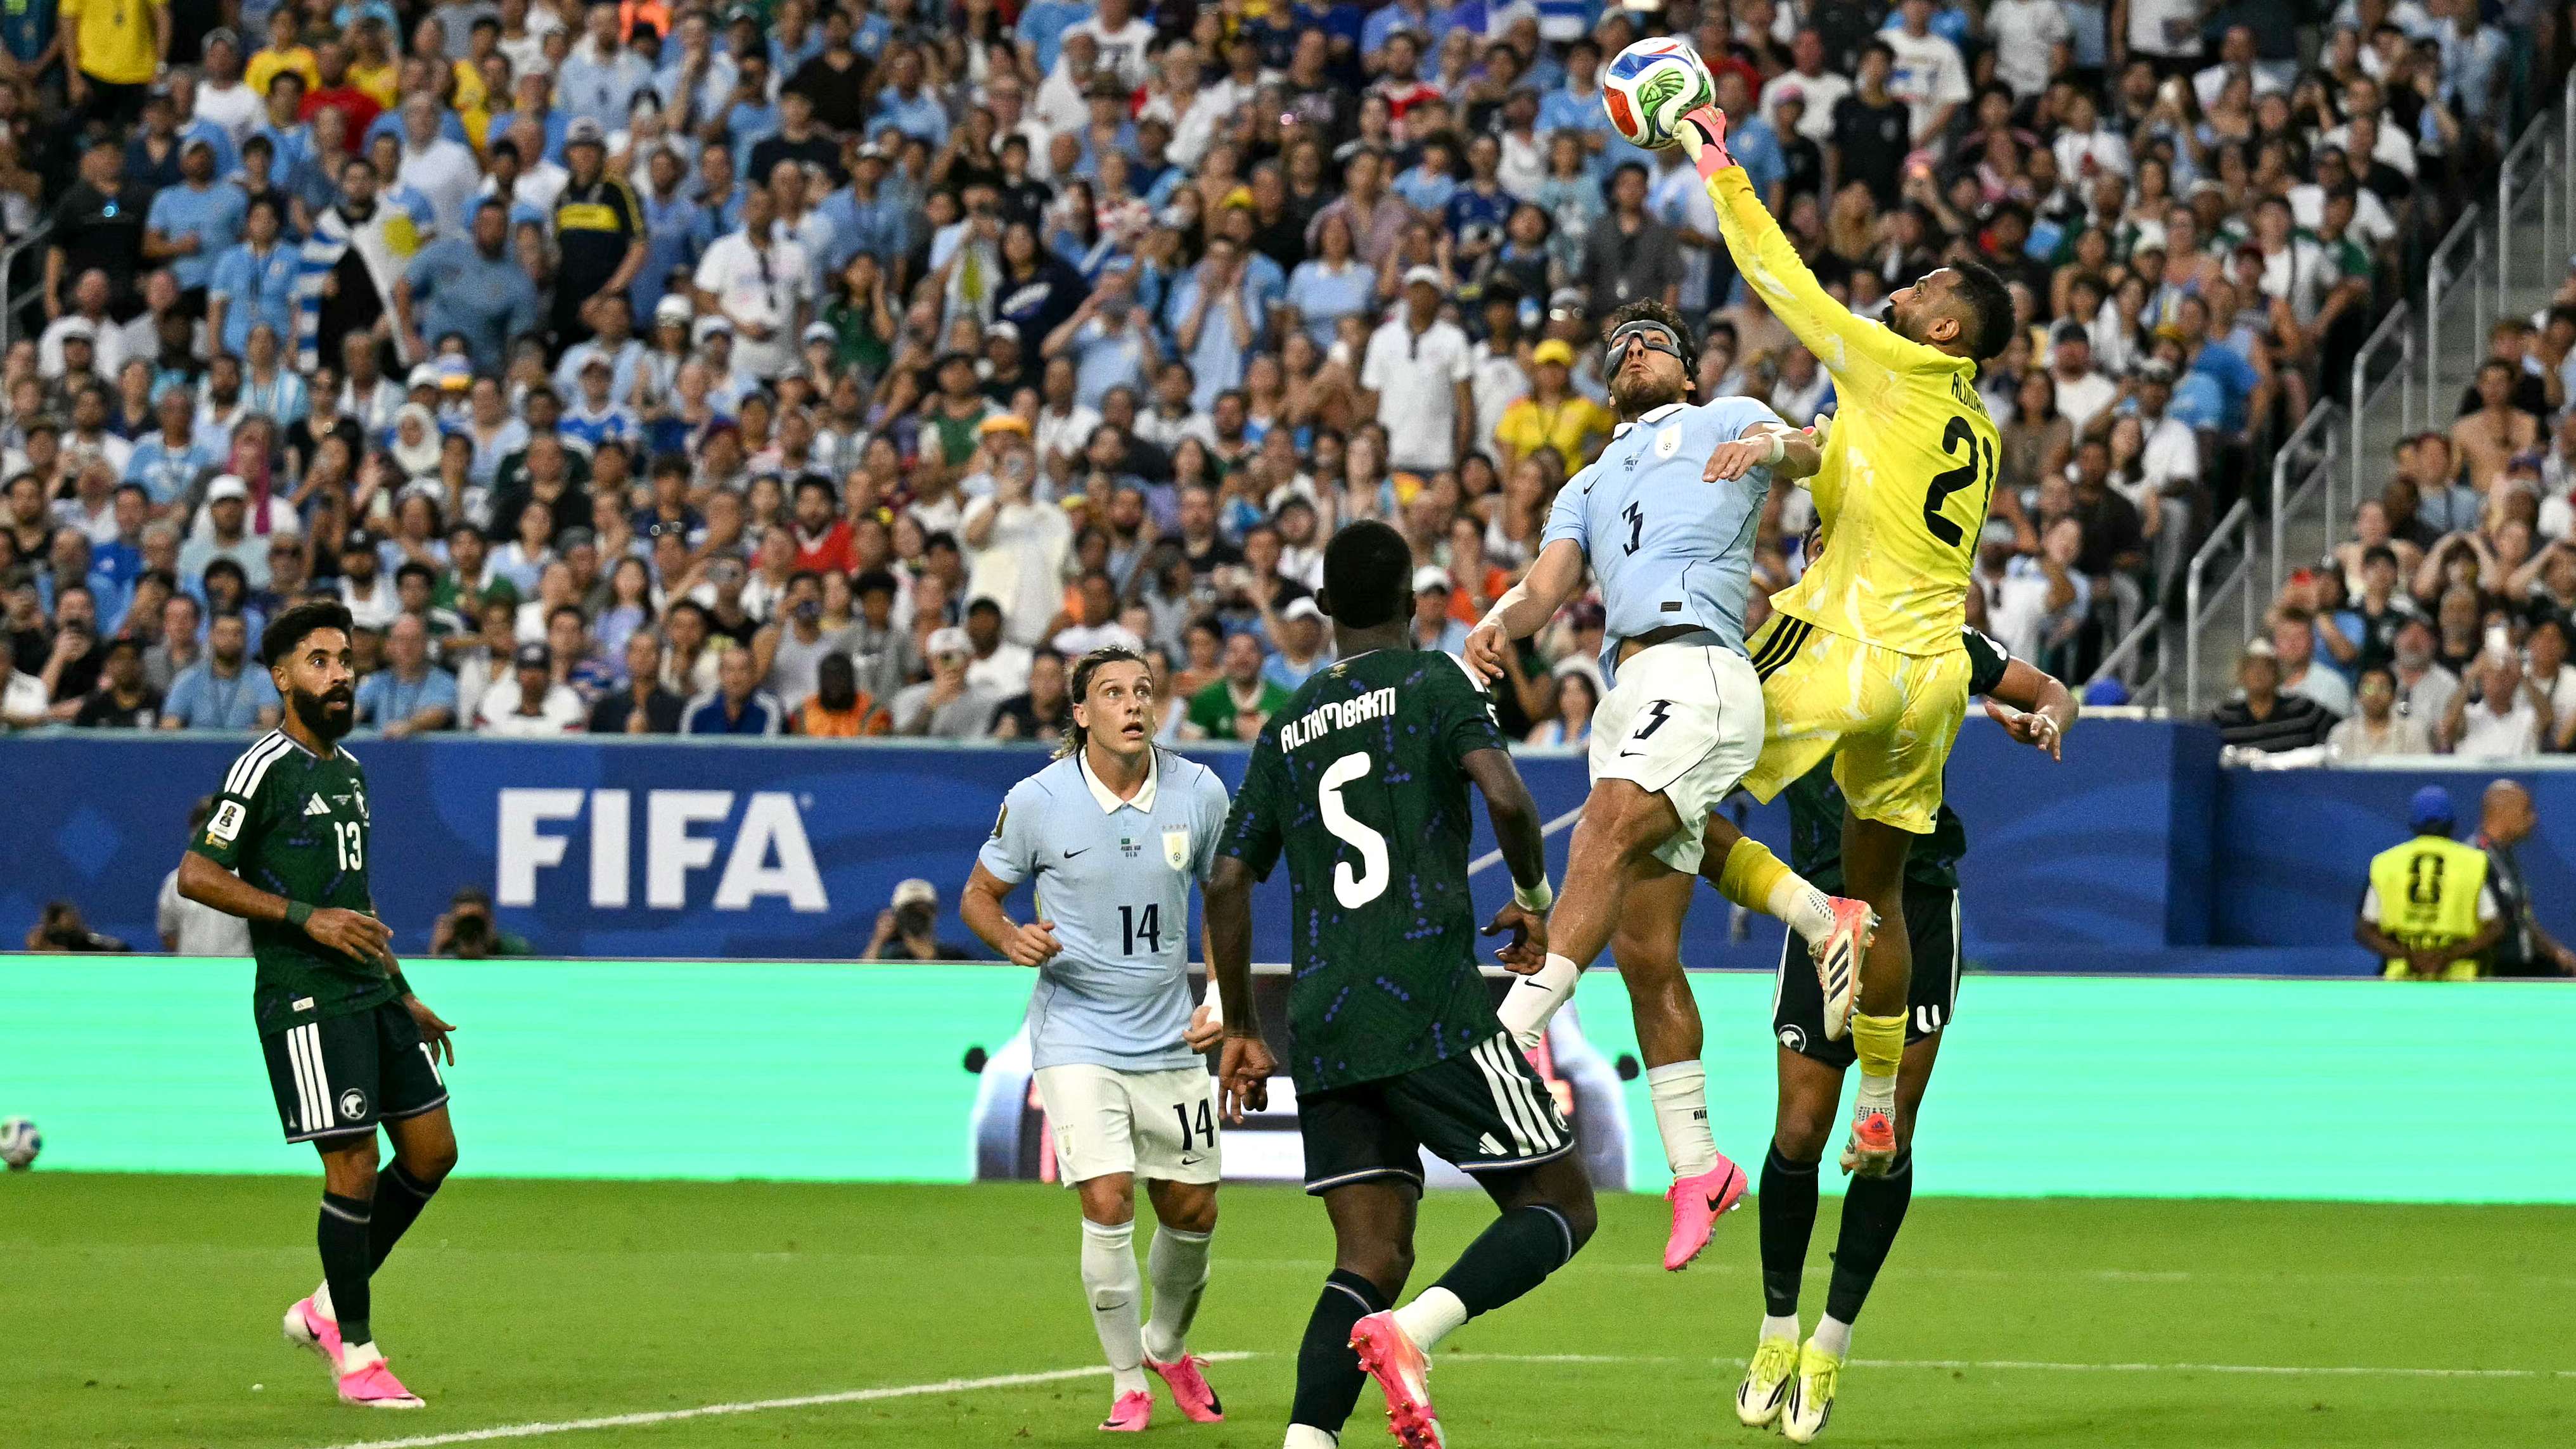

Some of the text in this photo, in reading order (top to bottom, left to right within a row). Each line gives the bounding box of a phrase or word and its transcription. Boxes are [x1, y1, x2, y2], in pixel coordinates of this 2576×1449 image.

[1923, 416, 1994, 560] 21
[1622, 500, 1643, 557] 3
[1280, 687, 1395, 754] ALTAMBAKTI
[1632, 699, 1672, 740] 3
[334, 821, 363, 871] 13
[496, 788, 830, 912] FIFA
[1318, 751, 1390, 909] 5
[1118, 903, 1160, 955] 14
[1173, 1098, 1214, 1151] 14
